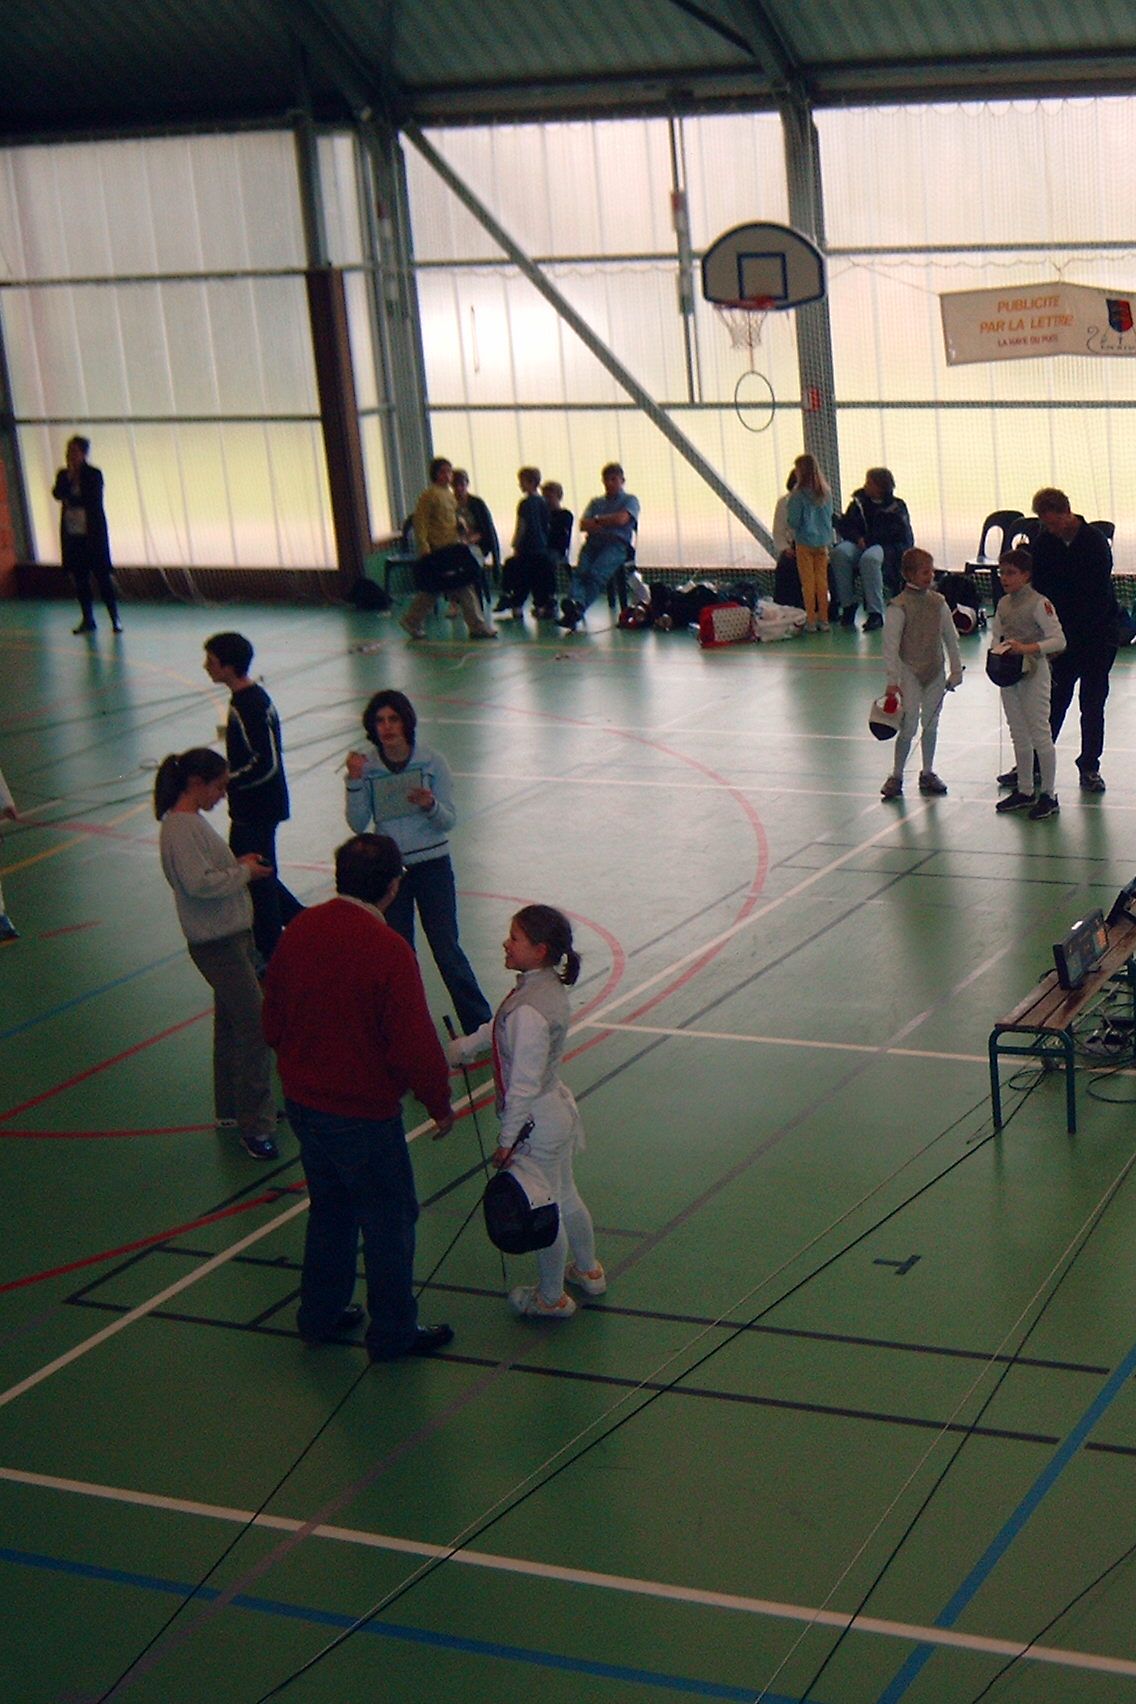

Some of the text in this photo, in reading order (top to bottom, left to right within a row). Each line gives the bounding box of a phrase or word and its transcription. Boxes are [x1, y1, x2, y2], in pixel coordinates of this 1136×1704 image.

[980, 315, 1074, 333] PAR LA LETTRE
